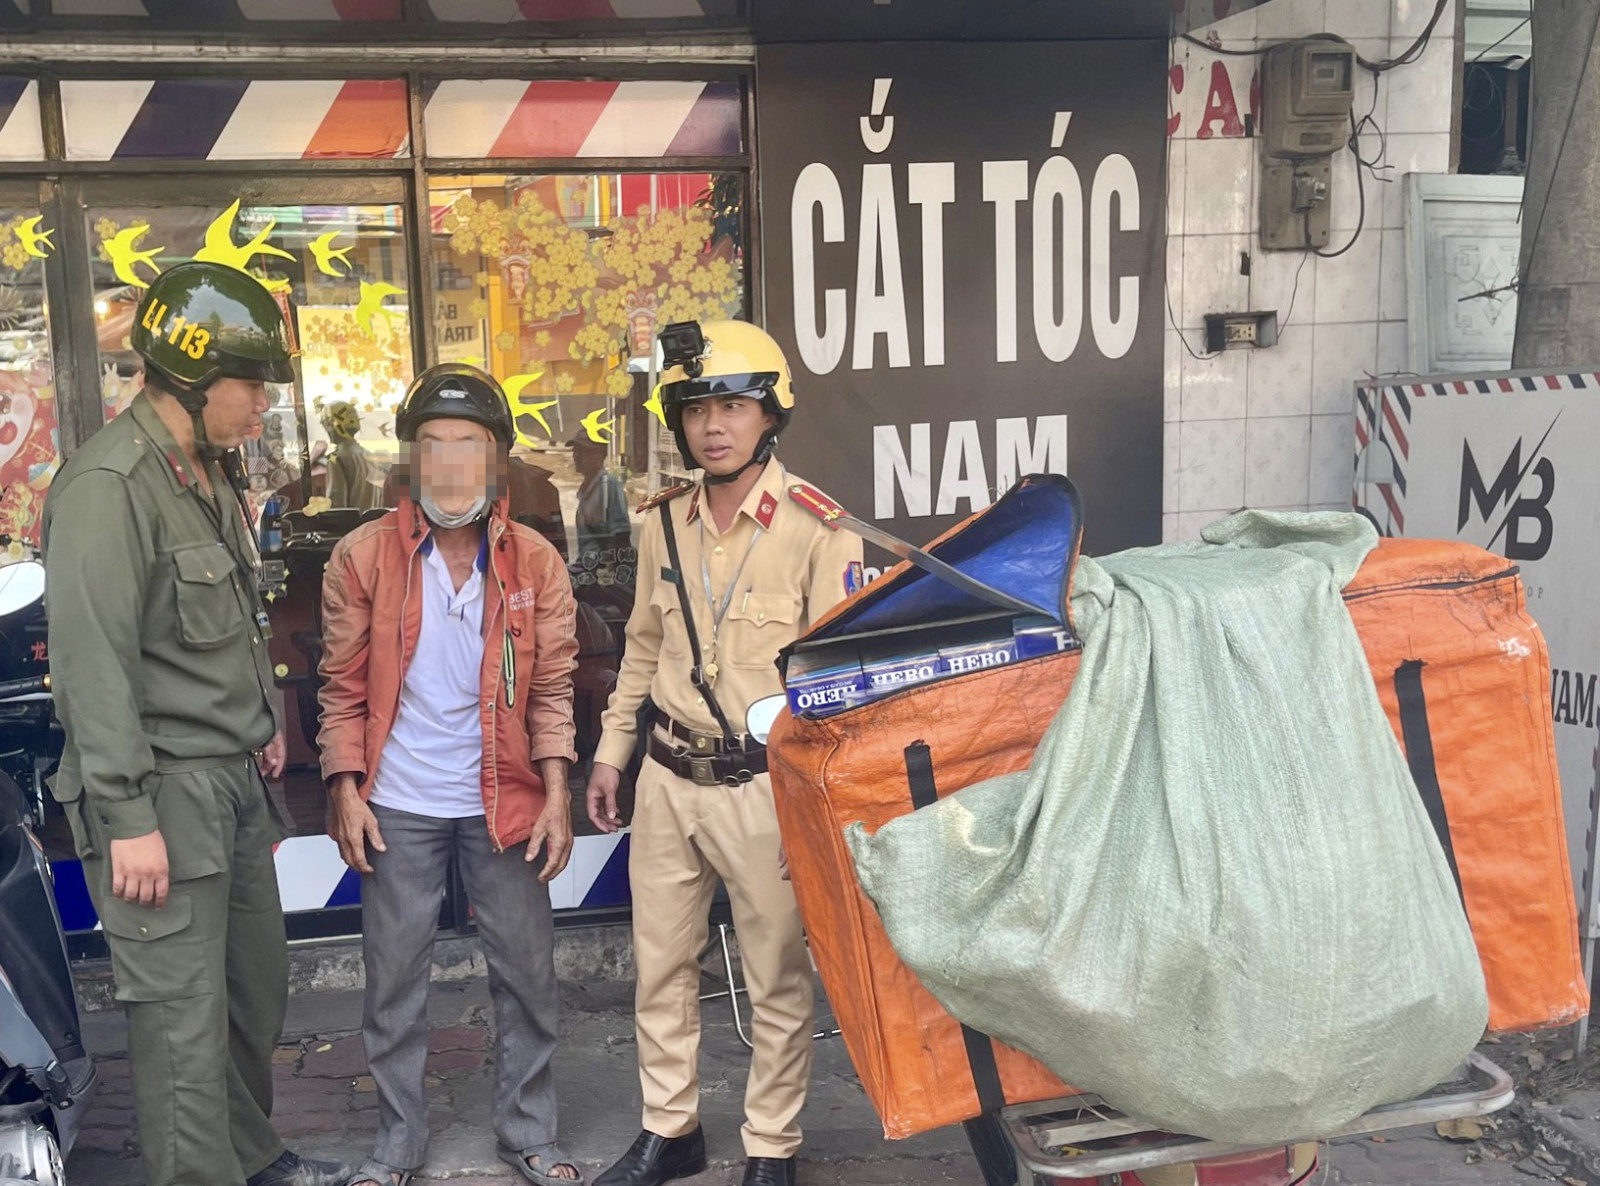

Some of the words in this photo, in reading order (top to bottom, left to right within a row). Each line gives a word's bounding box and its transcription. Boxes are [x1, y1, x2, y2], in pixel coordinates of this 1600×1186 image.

[791, 78, 956, 375] CẮT
[982, 111, 1140, 362] TÓC
[142, 298, 168, 337] LL
[168, 315, 210, 359] 113
[873, 415, 1068, 519] NAM
[1527, 586, 1544, 599] OP
[871, 665, 935, 686] HERO
[947, 650, 1011, 673] HERO
